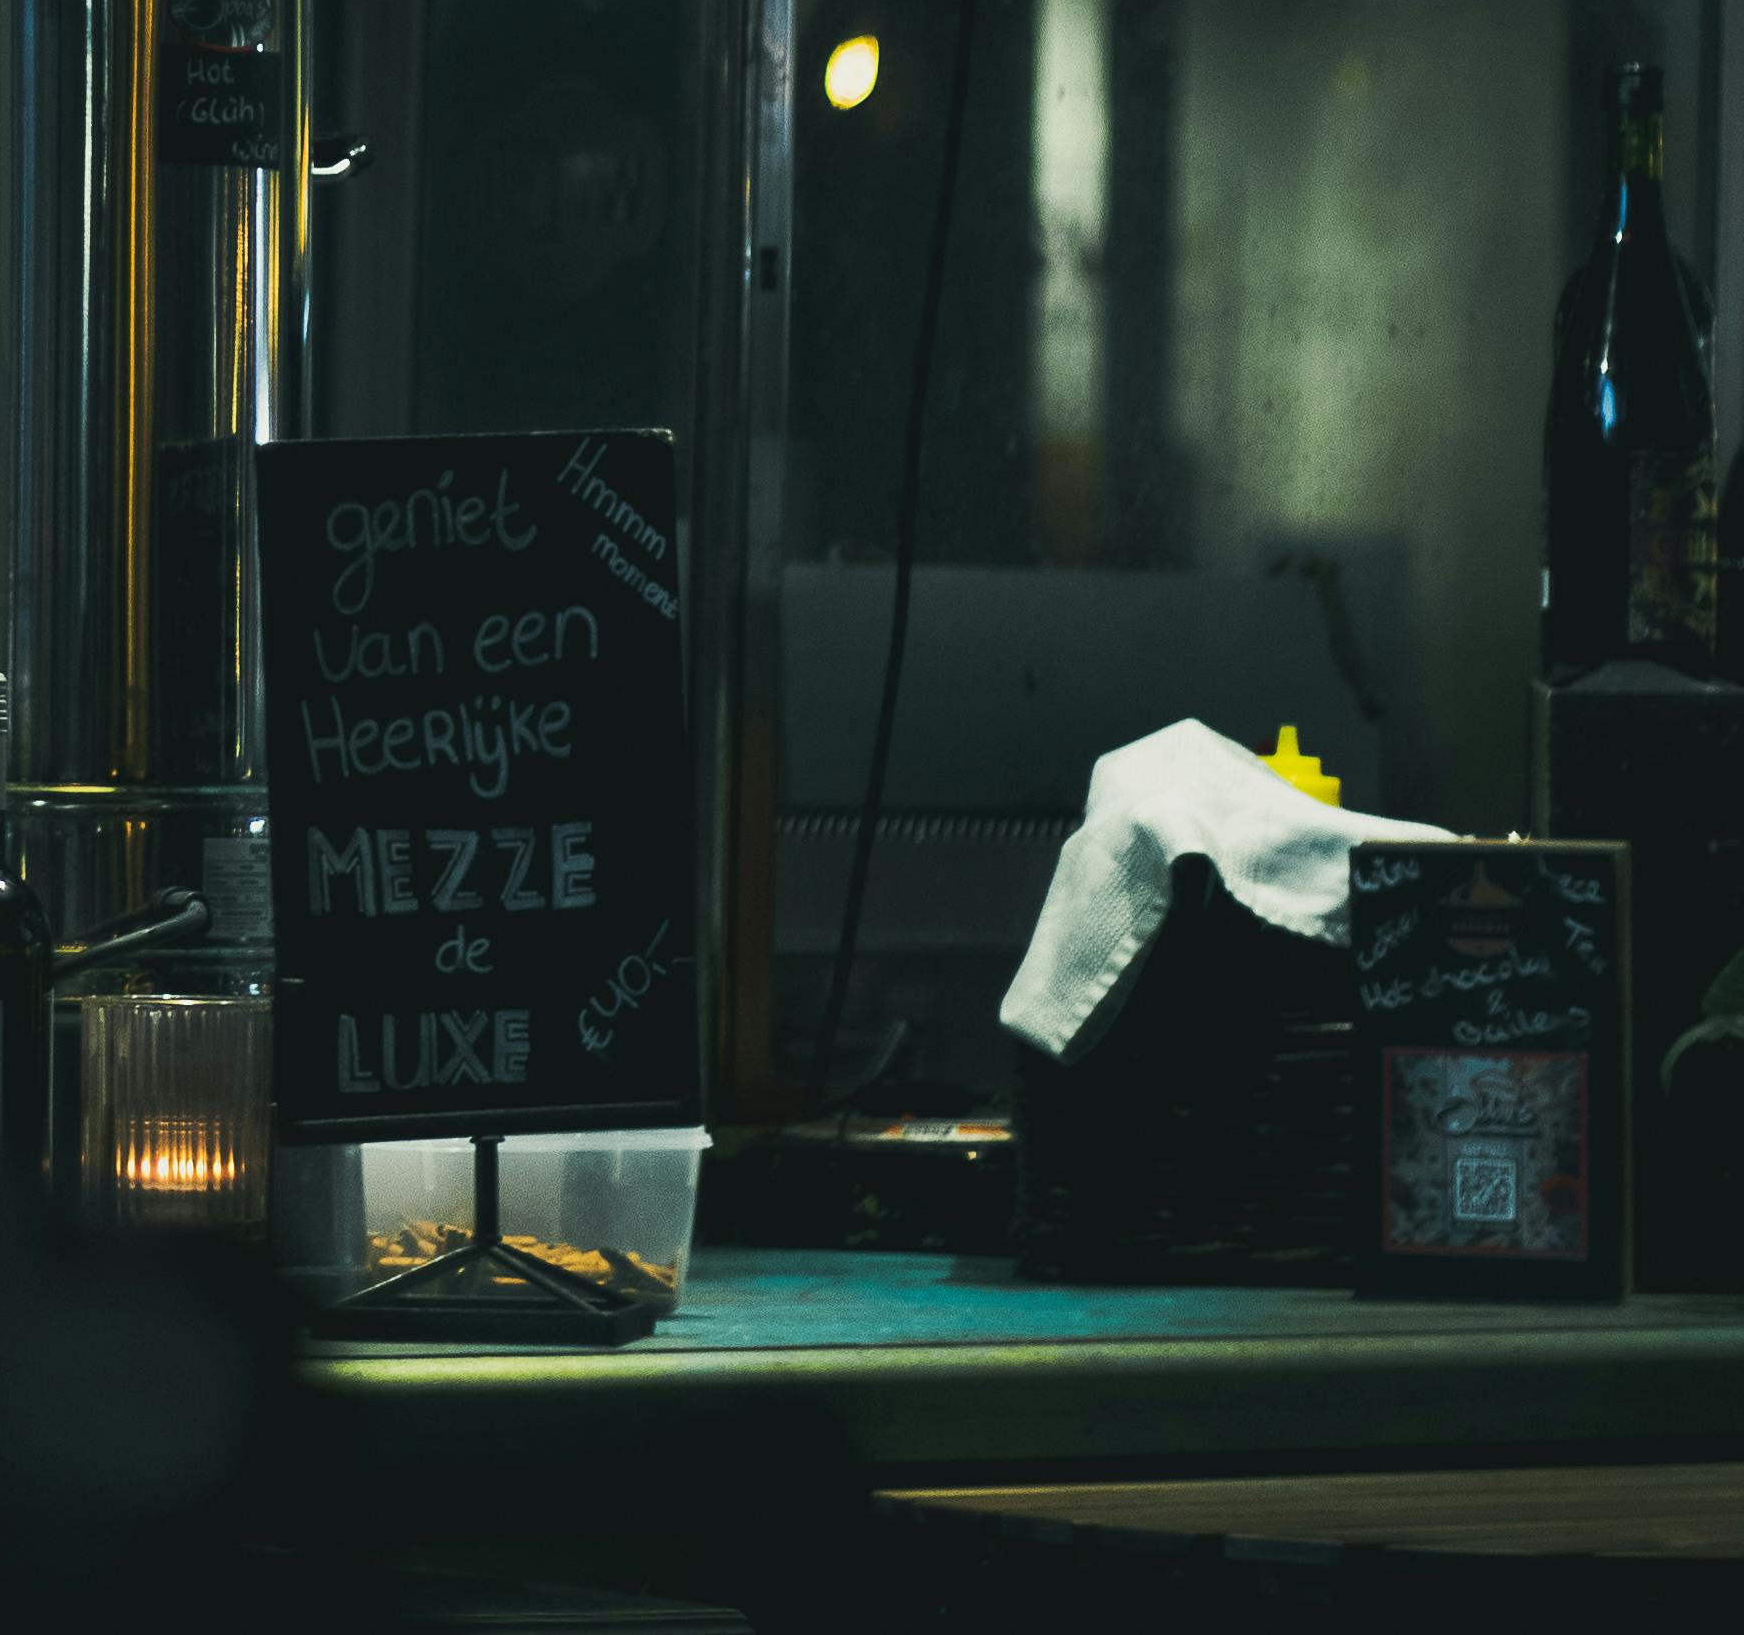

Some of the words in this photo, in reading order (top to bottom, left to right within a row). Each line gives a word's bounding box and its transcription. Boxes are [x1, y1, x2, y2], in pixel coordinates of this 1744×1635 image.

[186, 57, 235, 85] Hot
[556, 435, 667, 561] Hmmm
[326, 468, 539, 616] geniet
[473, 603, 599, 673] een
[306, 821, 597, 918] MEZZE
[435, 923, 494, 975] de
[336, 1007, 532, 1094] LUXE
